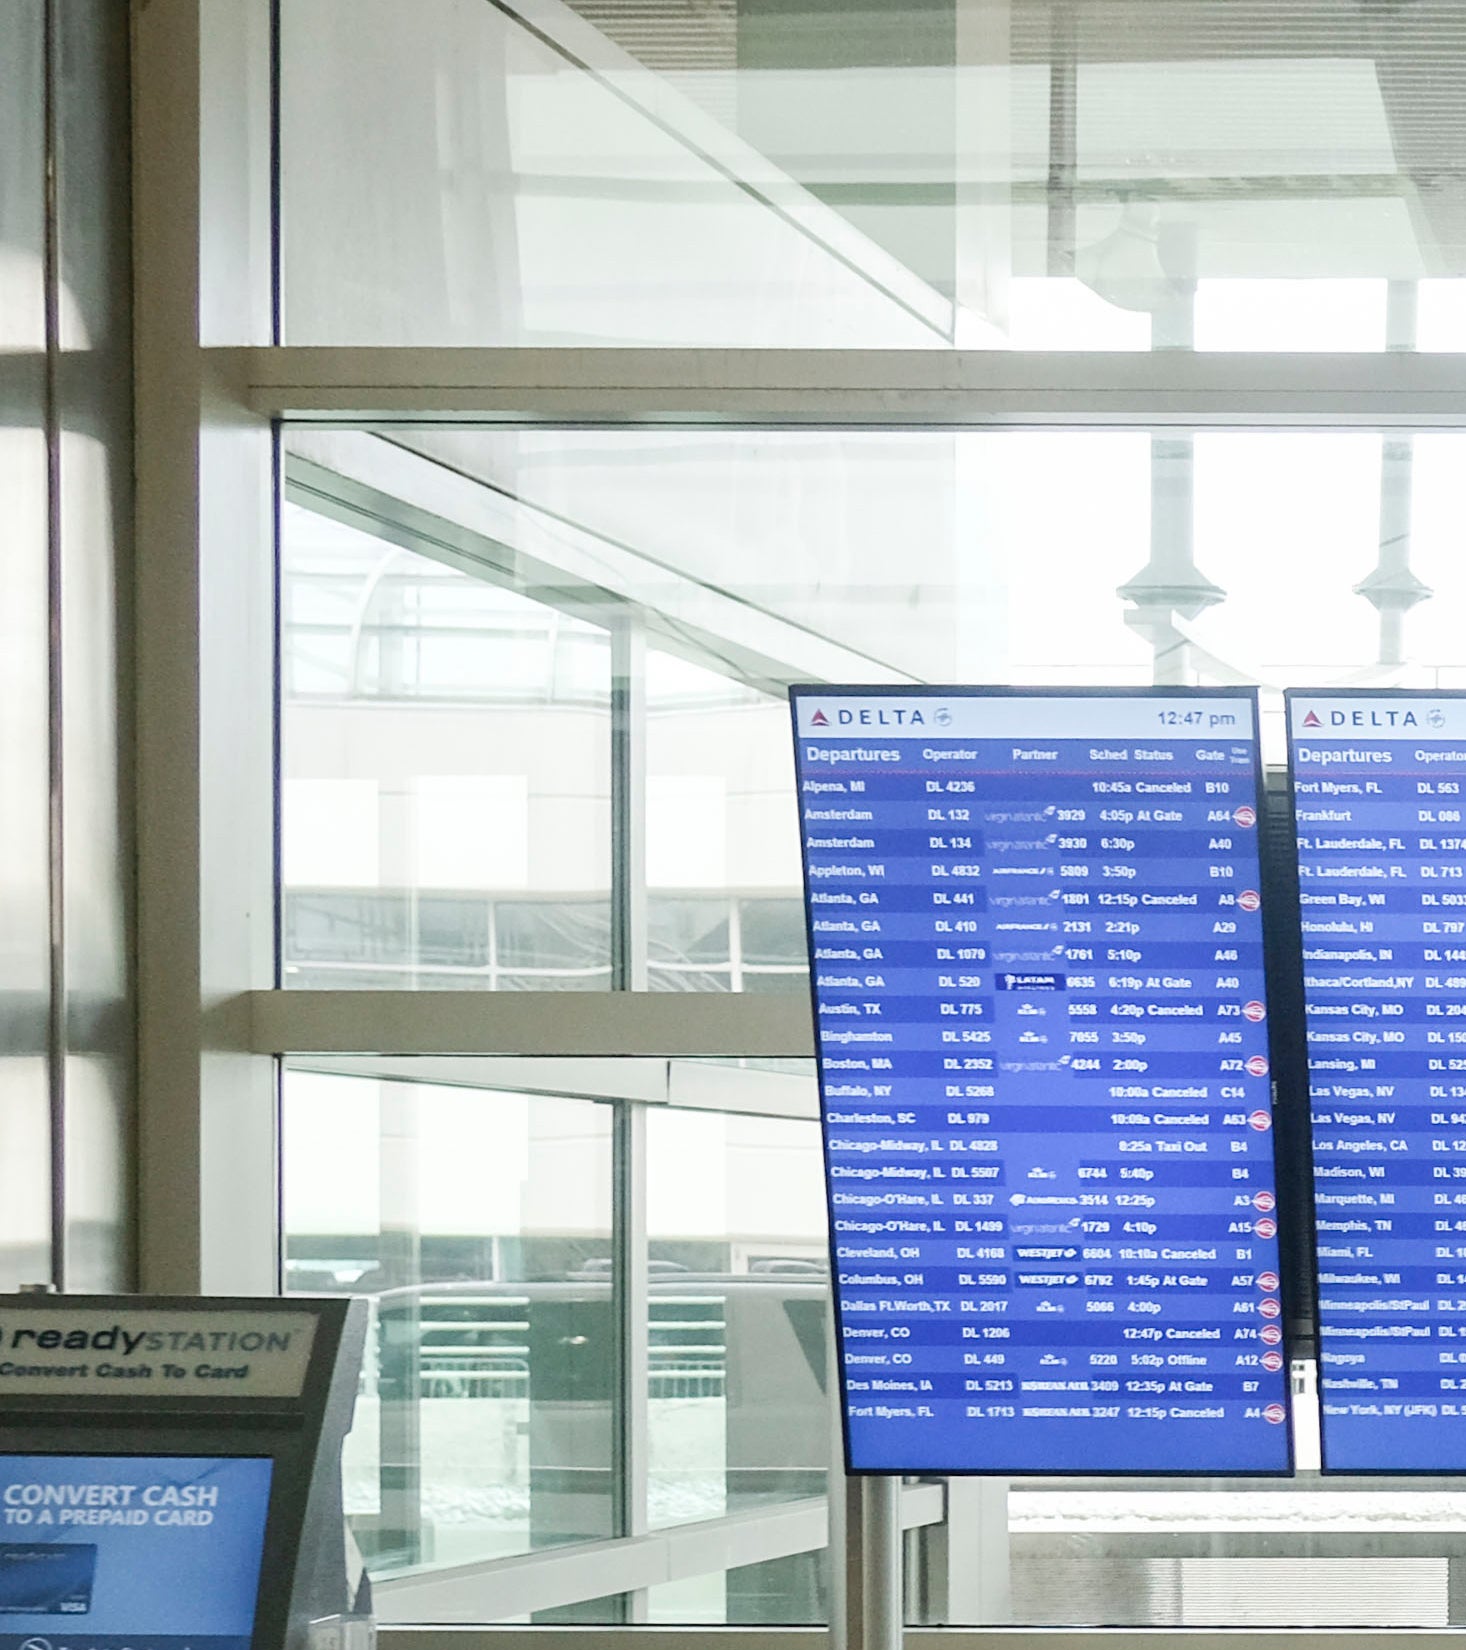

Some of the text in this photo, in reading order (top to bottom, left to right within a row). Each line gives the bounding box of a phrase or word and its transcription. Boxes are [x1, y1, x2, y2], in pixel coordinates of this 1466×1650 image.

[839, 710, 924, 724] DELTA
[1158, 711, 1235, 728] 12:47 pm
[1331, 711, 1417, 726] DELTA
[807, 747, 900, 765] Departures
[923, 749, 977, 762] Operator
[1013, 749, 1058, 760] Partner
[1090, 749, 1128, 760] Sched
[1134, 749, 1173, 760] Status
[1196, 750, 1225, 760] Gate
[1299, 748, 1392, 765] Departures
[926, 781, 944, 792] DL
[946, 781, 975, 792] 4236
[1093, 782, 1131, 792] 10:45a
[1136, 782, 1191, 793] Canceled
[1206, 782, 1229, 793] B10
[805, 809, 873, 820] Amsterdam
[928, 809, 946, 820] DL
[948, 809, 969, 820] 132
[1057, 810, 1085, 820] 3929
[1100, 810, 1133, 823] 4:05p
[1137, 810, 1151, 821] At
[1154, 810, 1182, 821] Gate
[1308, 1059, 1358, 1071] Lansing,
[1429, 1059, 1446, 1070] DL
[1314, 1166, 1366, 1178] Madison,
[1368, 1167, 1384, 1177] WI
[1434, 1167, 1451, 1177] DL
[0, 1362, 249, 1378] Convert Cash To Card
[3, 1484, 219, 1507] CONVERT CASH
[4, 1509, 214, 1526] TO A PREPAID CARD
[60, 1603, 87, 1612] VISA
